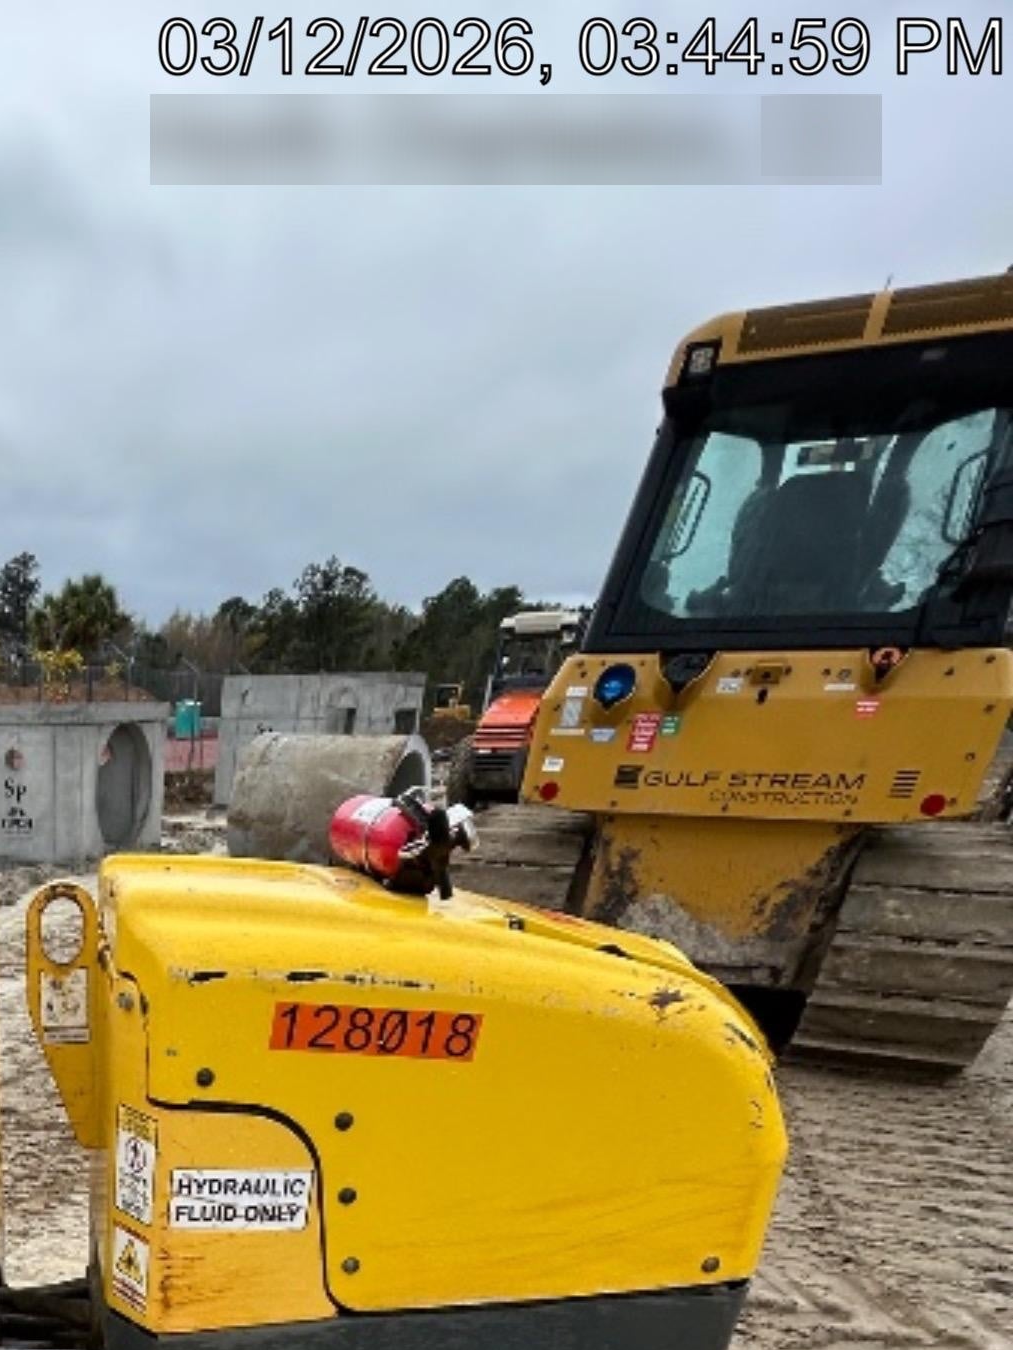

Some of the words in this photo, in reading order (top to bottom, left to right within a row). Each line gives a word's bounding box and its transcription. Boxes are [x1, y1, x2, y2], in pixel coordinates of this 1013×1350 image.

[643, 770, 720, 787] GULF
[727, 772, 866, 790] STREAM
[709, 789, 859, 806] CONSTRUCTION
[278, 1003, 477, 1058] 128018
[177, 1177, 306, 1197] HYDRAULIC
